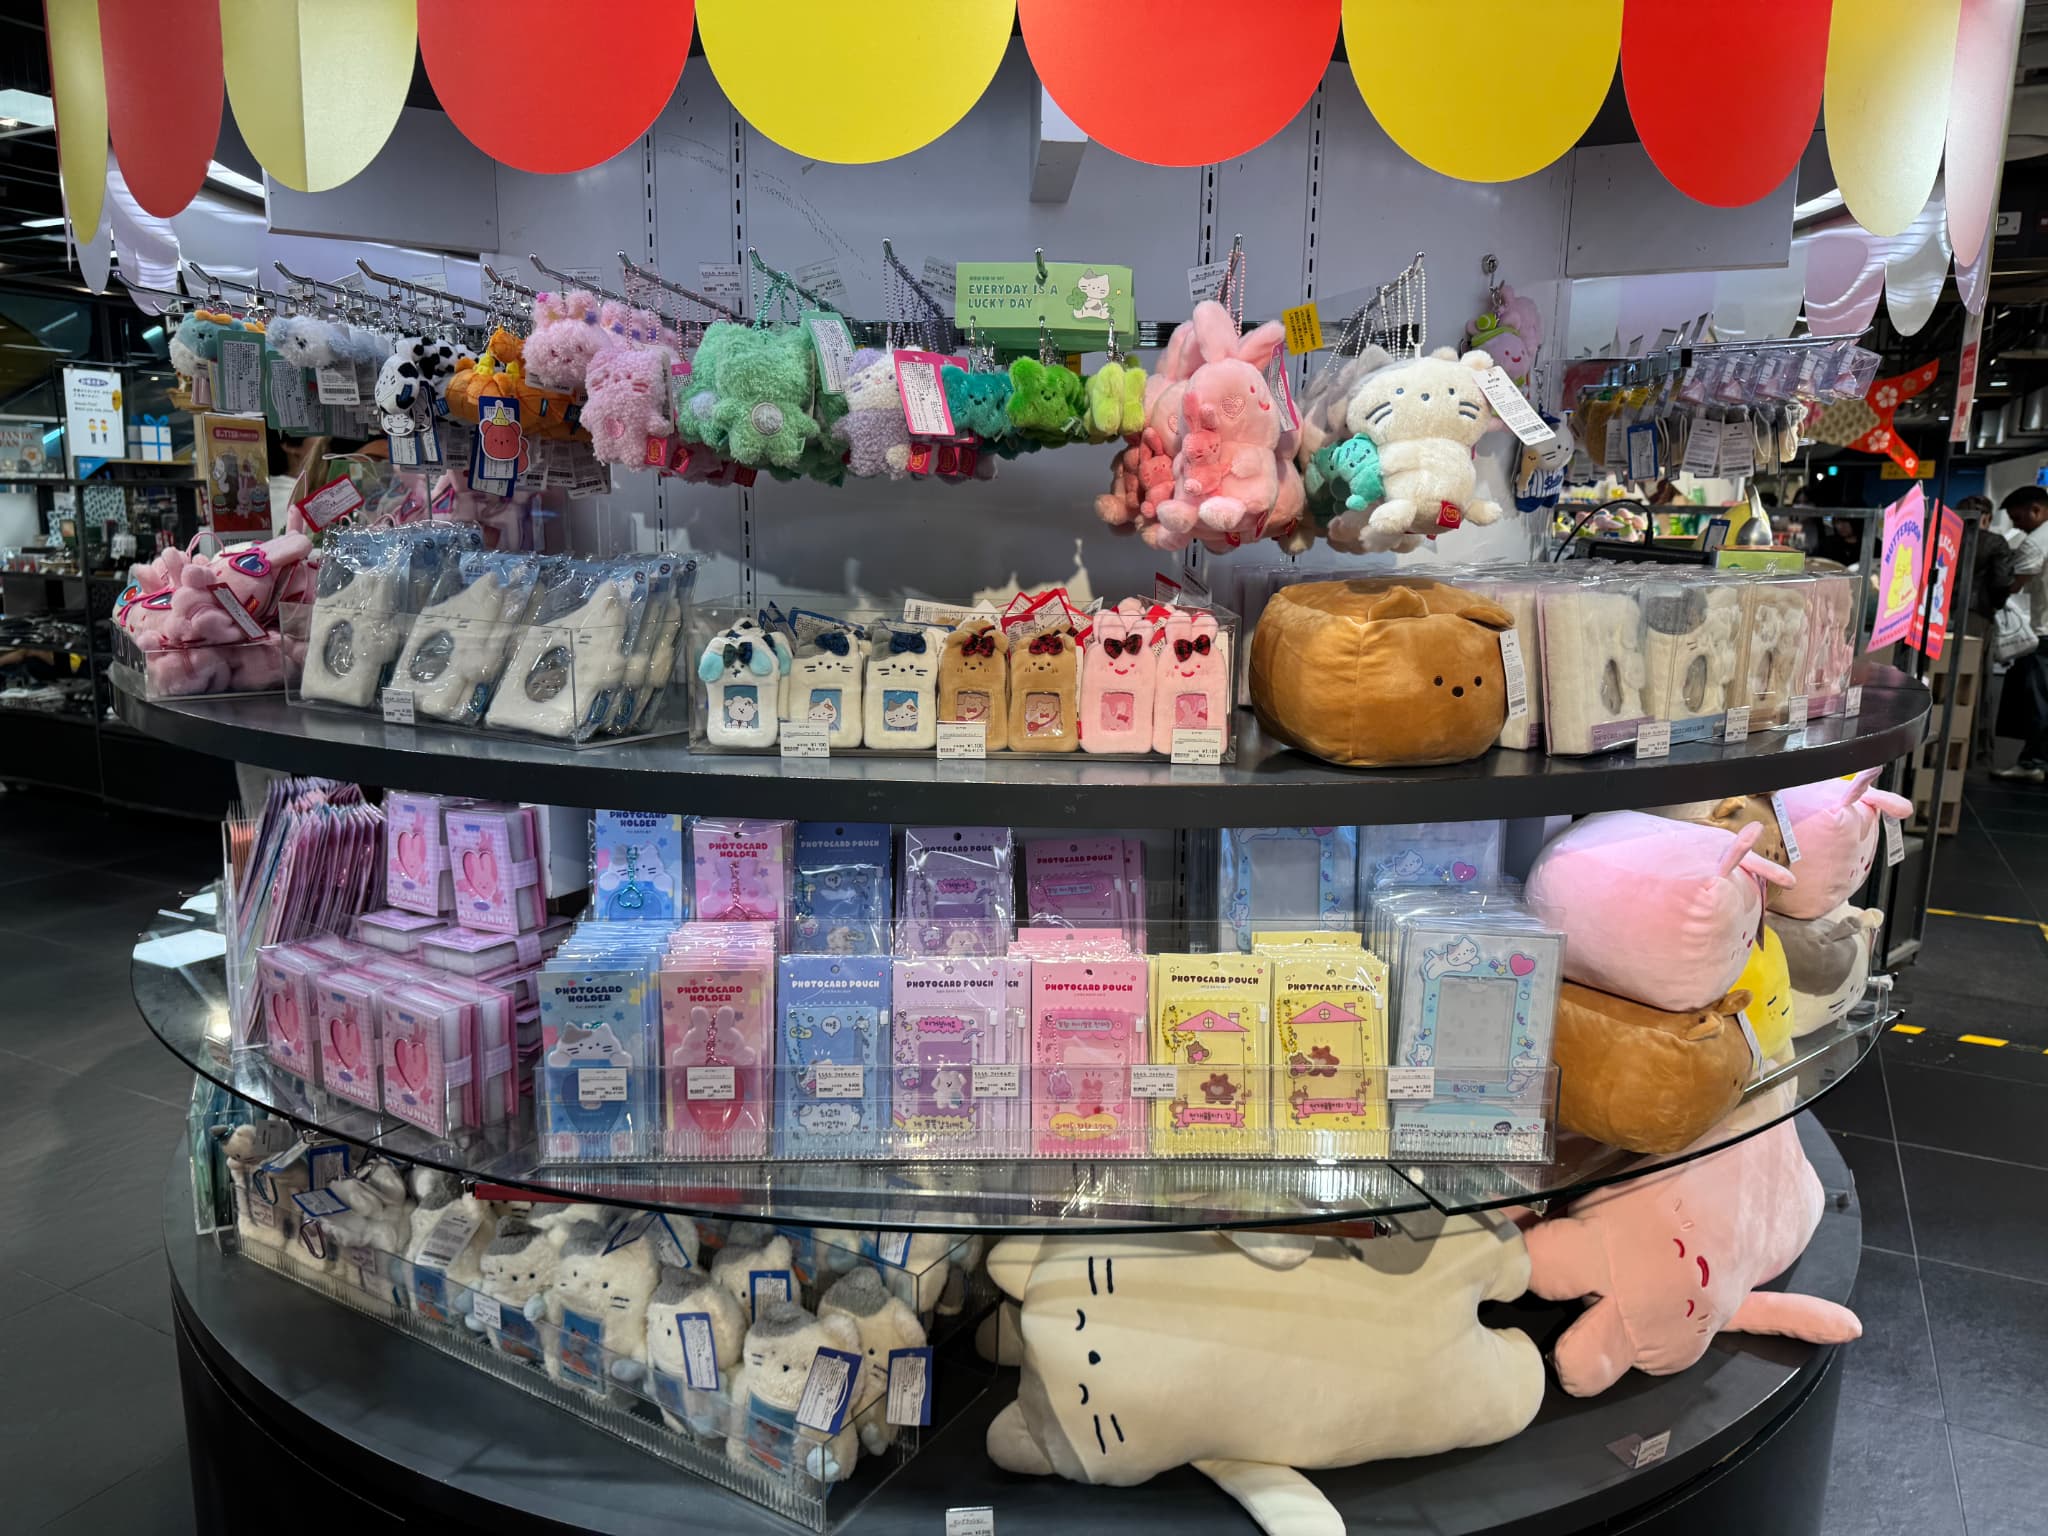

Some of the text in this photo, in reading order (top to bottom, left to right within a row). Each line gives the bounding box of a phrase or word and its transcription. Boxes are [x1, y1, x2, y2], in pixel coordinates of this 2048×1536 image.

[968, 284, 1058, 295] EVERYDAY IS A
[968, 298, 1033, 308] LUCKY DAY
[609, 811, 668, 819] PHOTOCARD
[620, 819, 657, 828] HOLDER
[708, 842, 768, 851] PHOTOCARD
[800, 839, 880, 849] PHOTOCARD POUCH
[719, 850, 759, 859] HOLDER
[1037, 854, 1113, 865] PHOTOCARD POUCH
[1171, 974, 1259, 985] PHOTOCARD POUCH
[791, 980, 880, 989] PHOTOCARD POUCH
[906, 980, 994, 989] PHOTOCARD POUCH
[1045, 983, 1133, 992] PHOTOCARD POUCH
[555, 985, 623, 995] PHOTOCARD
[677, 985, 744, 994] PHOTOCARD
[568, 994, 612, 1003] HOLDER
[689, 994, 732, 1002] HOLDER
